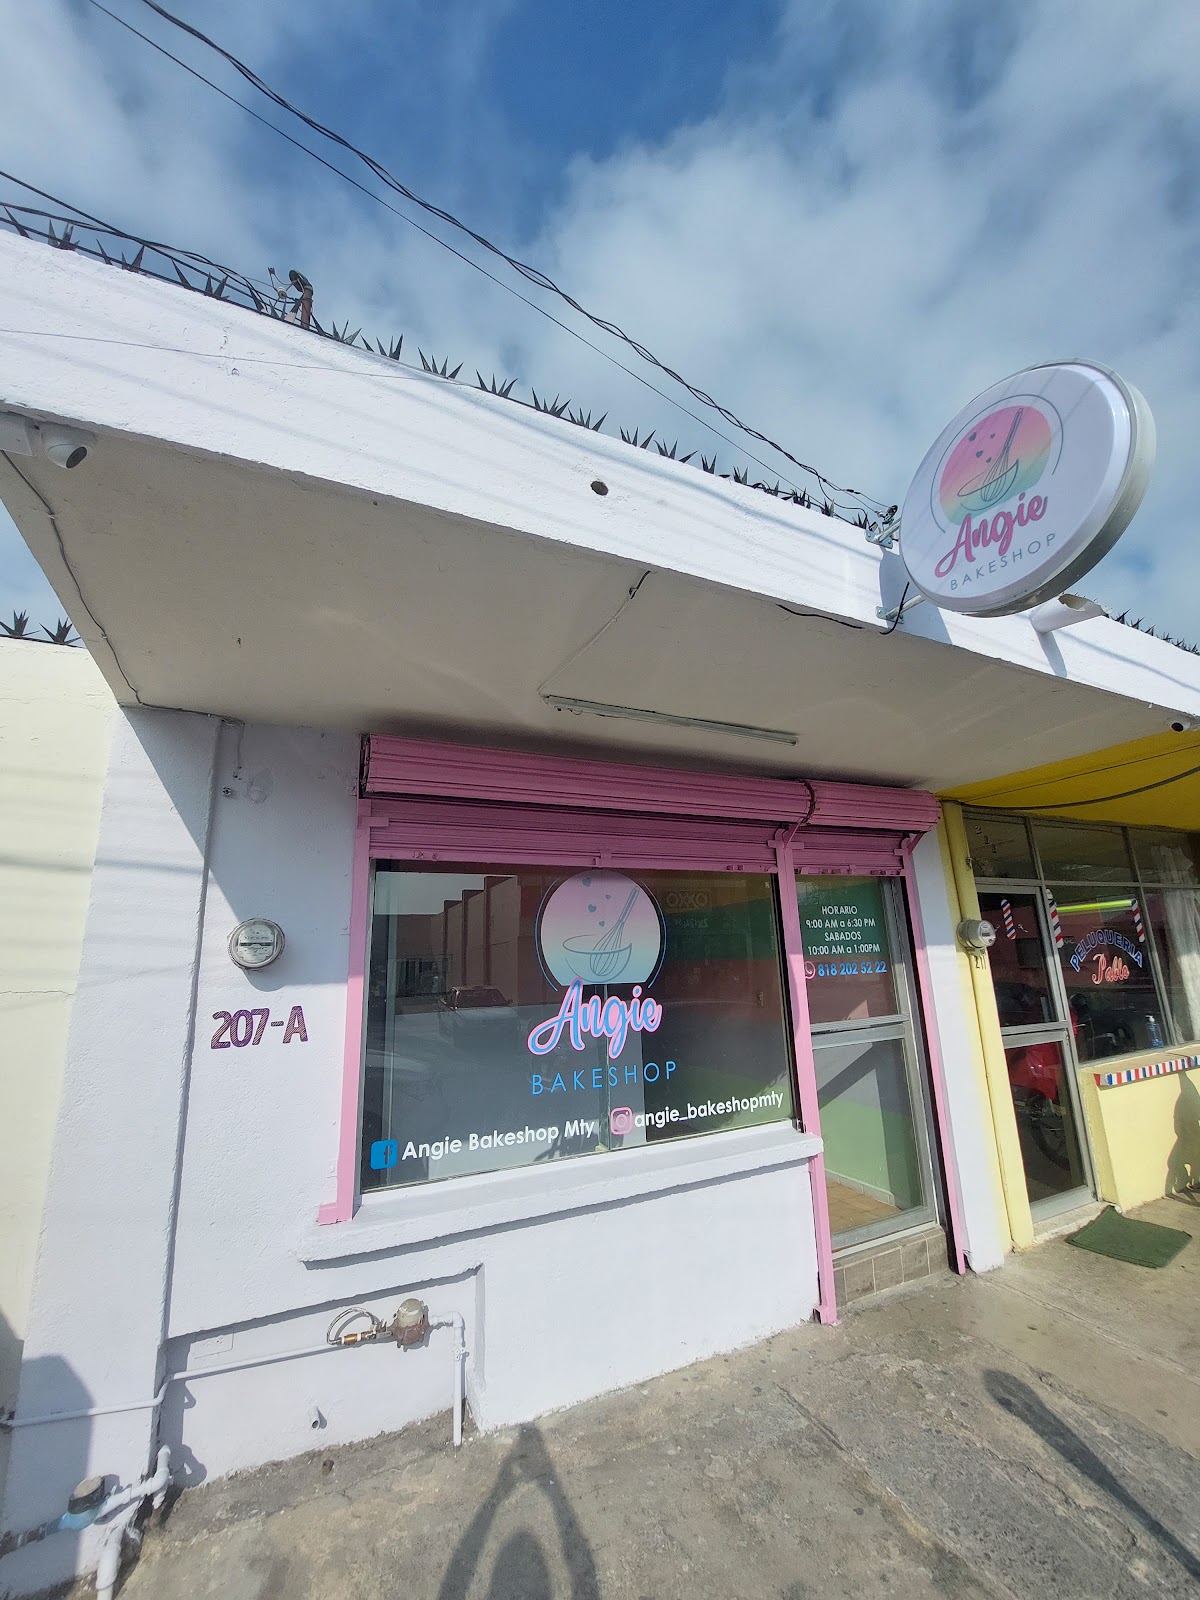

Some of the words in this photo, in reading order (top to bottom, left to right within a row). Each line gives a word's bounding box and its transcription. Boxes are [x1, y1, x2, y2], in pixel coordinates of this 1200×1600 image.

[934, 491, 1049, 578] Angie
[950, 532, 1057, 591] BAKESHOP
[805, 919, 823, 929] 9:00
[824, 919, 839, 928] AM
[847, 918, 862, 928] 6:30
[863, 918, 876, 927] PM
[821, 905, 858, 915] HORARIO
[807, 945, 829, 956] 10:00
[831, 945, 845, 954] AM
[824, 931, 862, 942] SABADOS
[1069, 929, 1143, 973] PELUQUERIA
[817, 963, 838, 977] 818
[839, 962, 859, 976] 202
[860, 961, 873, 974] 52
[874, 960, 887, 973] 22
[1091, 952, 1130, 985] Pablo
[210, 1005, 309, 1050] 207-A
[527, 976, 663, 1059] Angie
[531, 1061, 678, 1096] BAKESHOP
[634, 1091, 784, 1128] angie_bakeshopmty
[401, 1136, 461, 1160] Angie
[468, 1123, 559, 1152] Bakeshop
[564, 1118, 595, 1140] Mty
